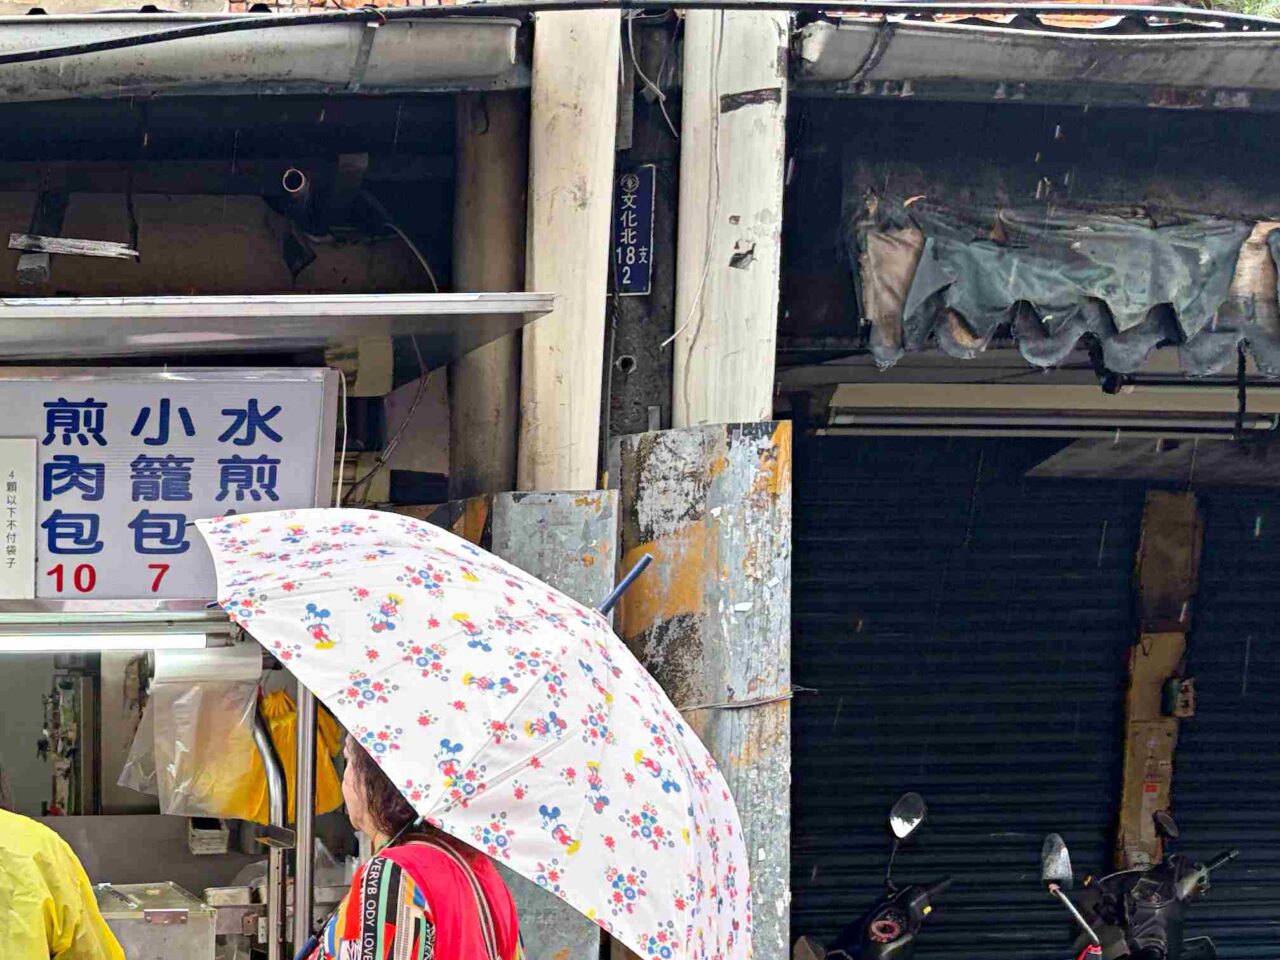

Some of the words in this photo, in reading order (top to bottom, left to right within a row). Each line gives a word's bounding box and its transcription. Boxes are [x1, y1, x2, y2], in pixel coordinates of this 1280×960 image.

[619, 193, 638, 245] 文化北
[621, 266, 632, 284] 2
[214, 397, 284, 517] 水煎
[40, 397, 108, 555] 煎肉包
[127, 397, 196, 555] 小籠包
[46, 563, 97, 593] 10
[146, 563, 170, 593] 7
[364, 899, 377, 927] ODY
[362, 932, 375, 960] LOVE
